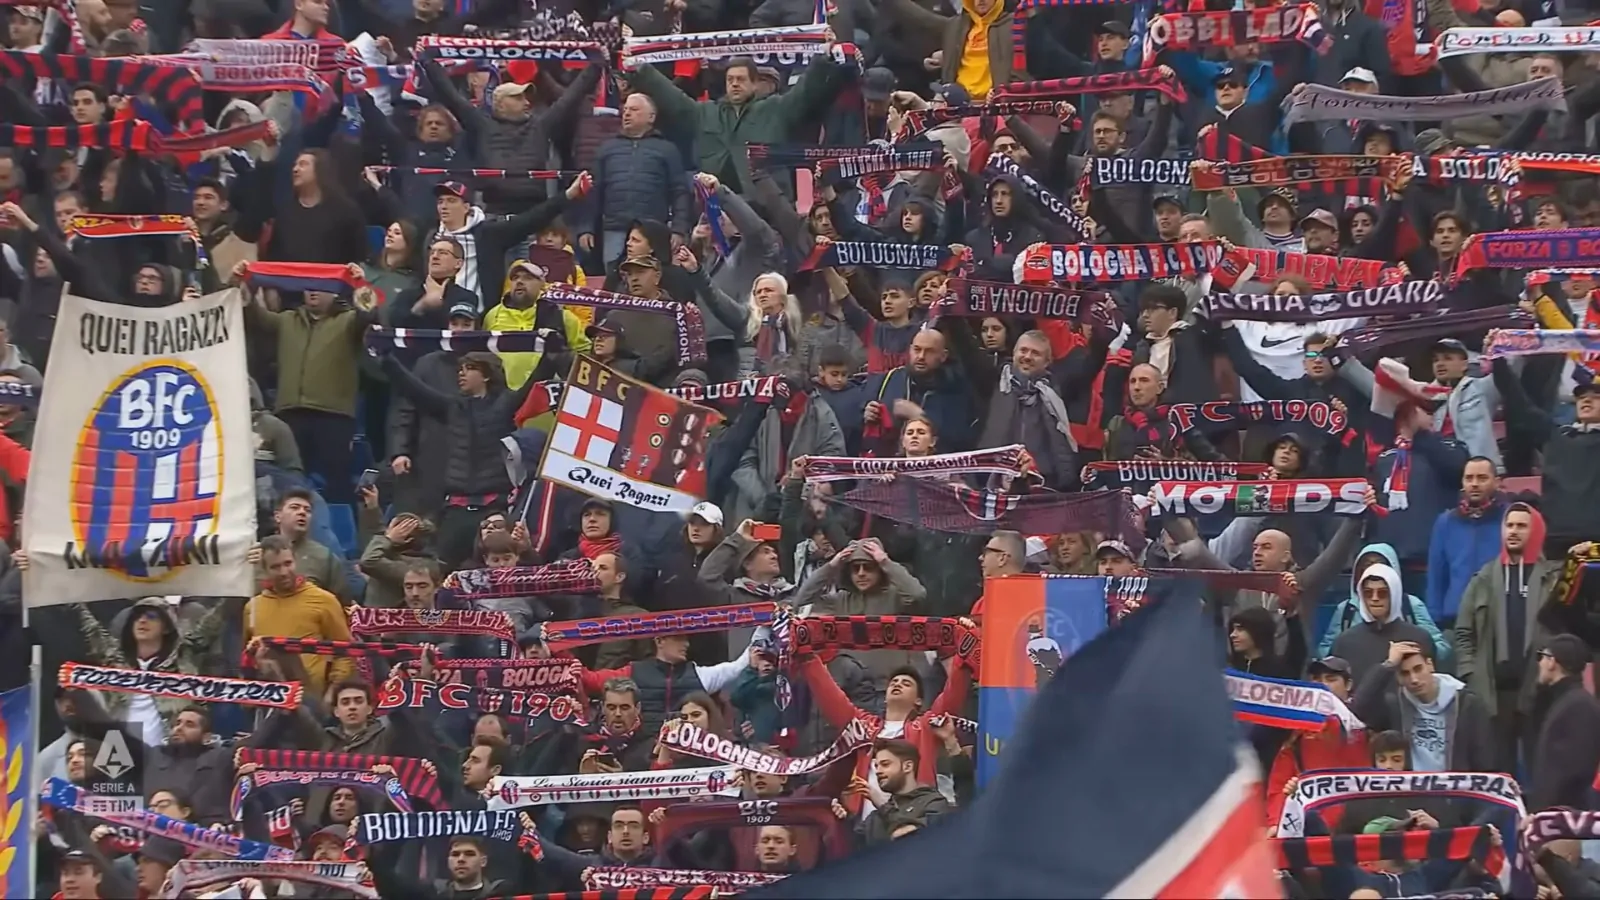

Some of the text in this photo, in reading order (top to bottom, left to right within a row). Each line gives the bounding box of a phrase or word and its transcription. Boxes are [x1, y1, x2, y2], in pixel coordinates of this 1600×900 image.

[439, 47, 588, 60] BOLOGNA
[836, 241, 921, 266] BOLOGNA
[1052, 248, 1149, 276] BOLOGNA
[1487, 240, 1551, 258] FORZA
[990, 286, 1081, 317] BOLOGNA
[80, 305, 230, 355] QUEI RAGAZZI
[118, 372, 196, 429] BFC
[1268, 400, 1348, 435] 1909
[129, 428, 182, 449] 1909
[1118, 461, 1216, 482] BOLOGNA
[568, 466, 671, 507] Quei Ragazzi
[577, 607, 756, 640] BOLOGNA
[378, 678, 471, 708] BFC
[617, 775, 666, 786] siamo
[737, 799, 778, 815] BFC
[746, 815, 771, 824] 1909
[364, 810, 517, 844] BOLOGNA FC
